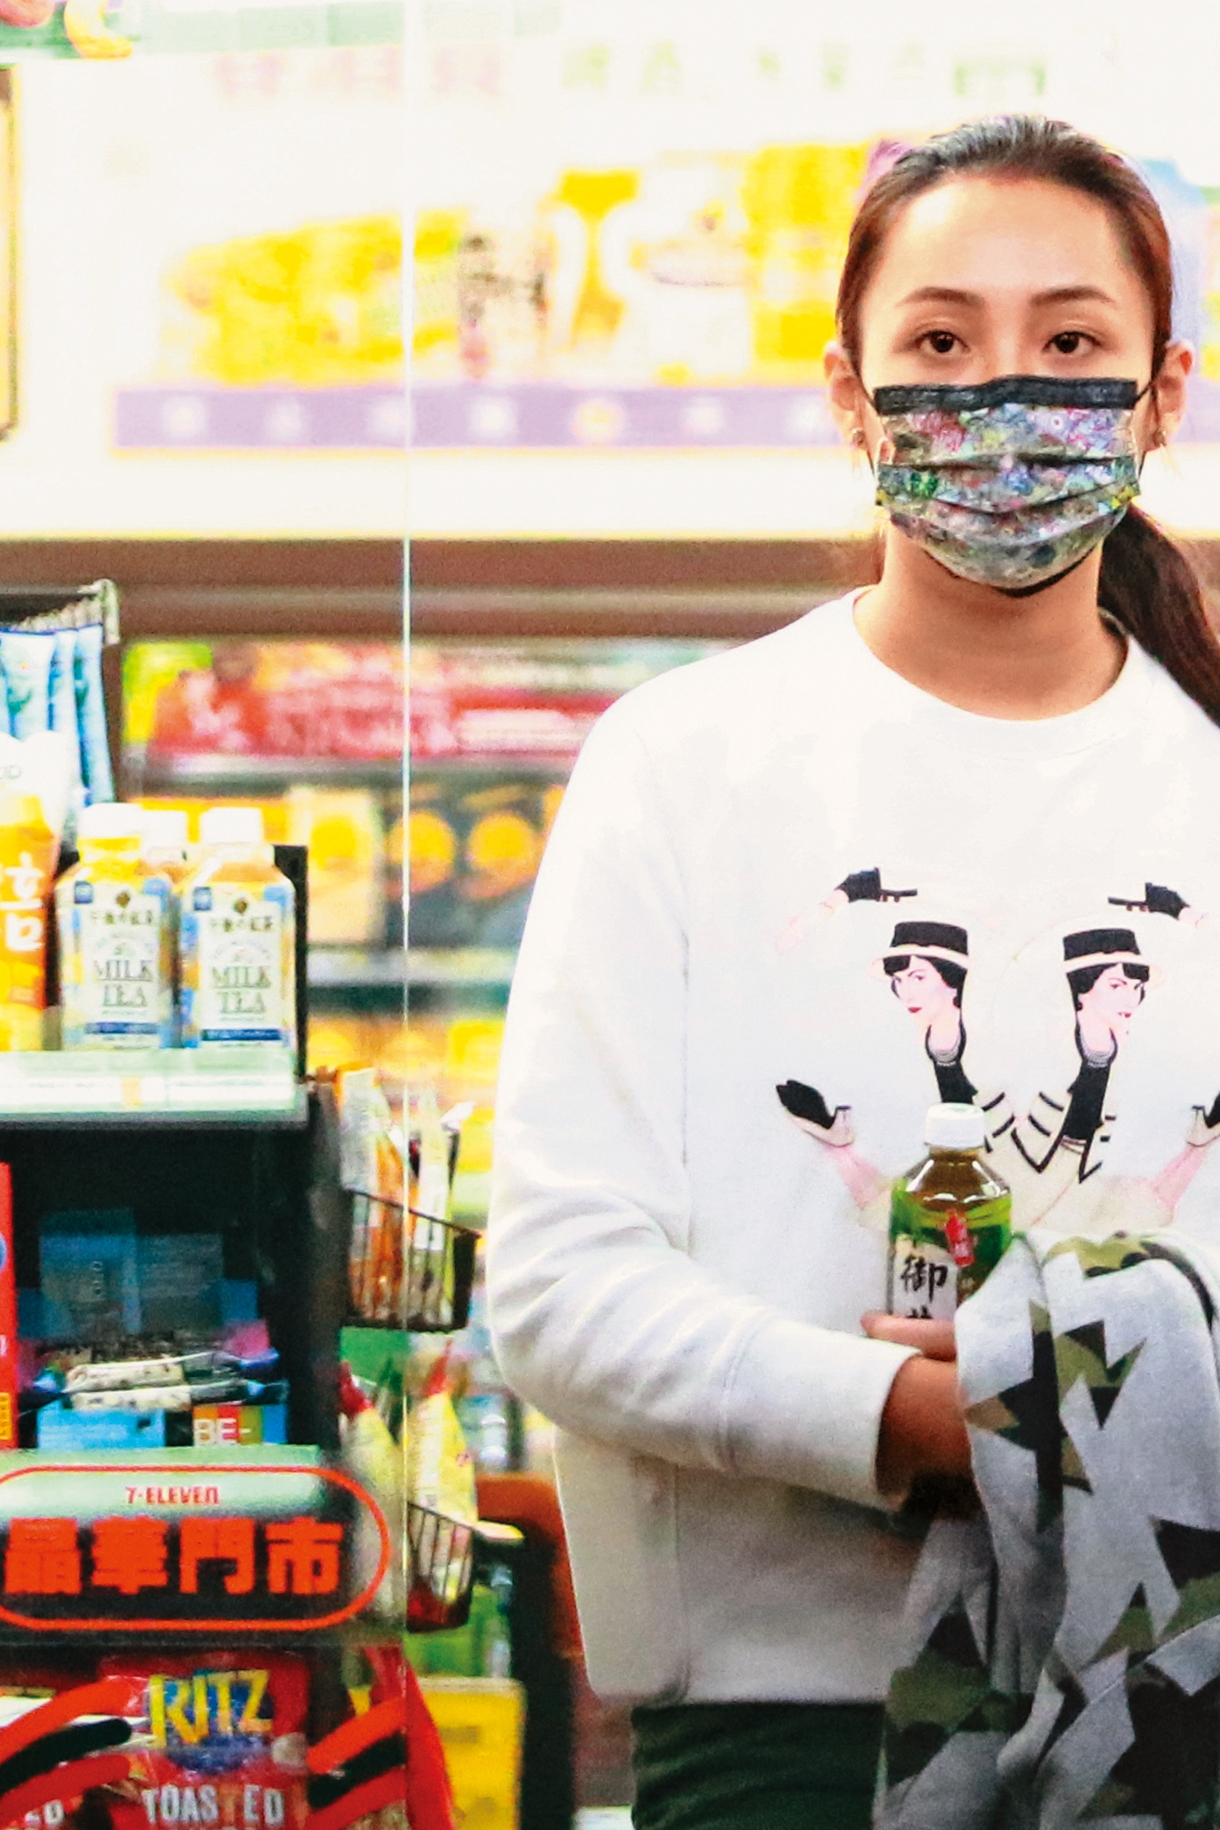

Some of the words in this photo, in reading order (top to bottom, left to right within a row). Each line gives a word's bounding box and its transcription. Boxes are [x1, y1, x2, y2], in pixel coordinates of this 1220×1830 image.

[211, 966, 271, 988] MILK
[217, 991, 266, 1014] TEA
[149, 1668, 273, 1748] RITZ
